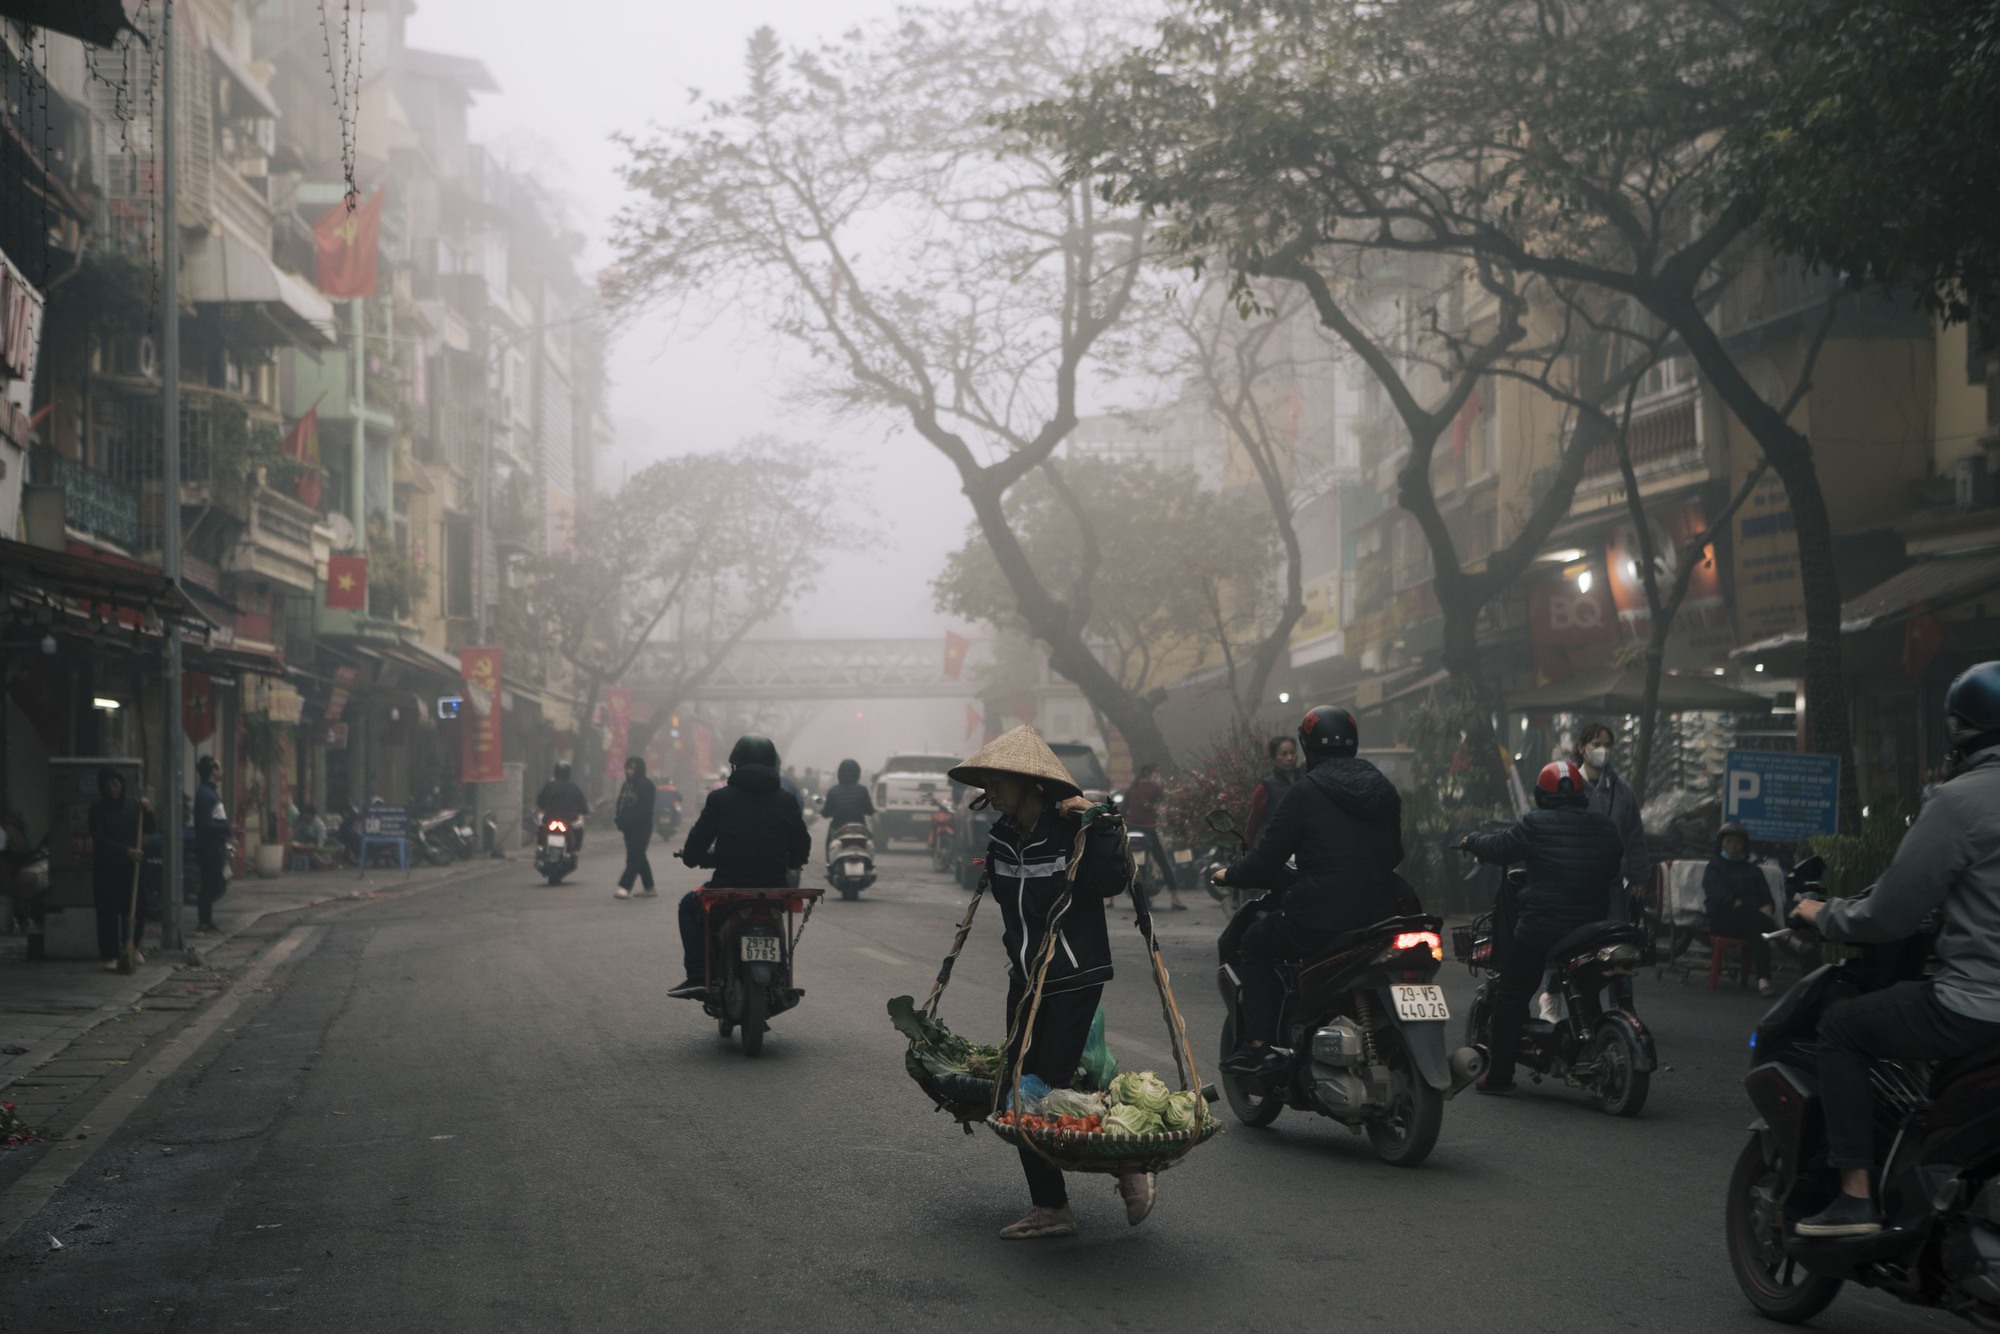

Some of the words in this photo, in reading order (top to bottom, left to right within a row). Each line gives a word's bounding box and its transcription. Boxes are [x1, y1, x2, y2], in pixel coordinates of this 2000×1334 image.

[1550, 597, 1604, 629] BQ
[1729, 770, 1760, 816] P
[1399, 986, 1437, 1001] 29-V5
[1401, 1002, 1447, 1018] 440.26
